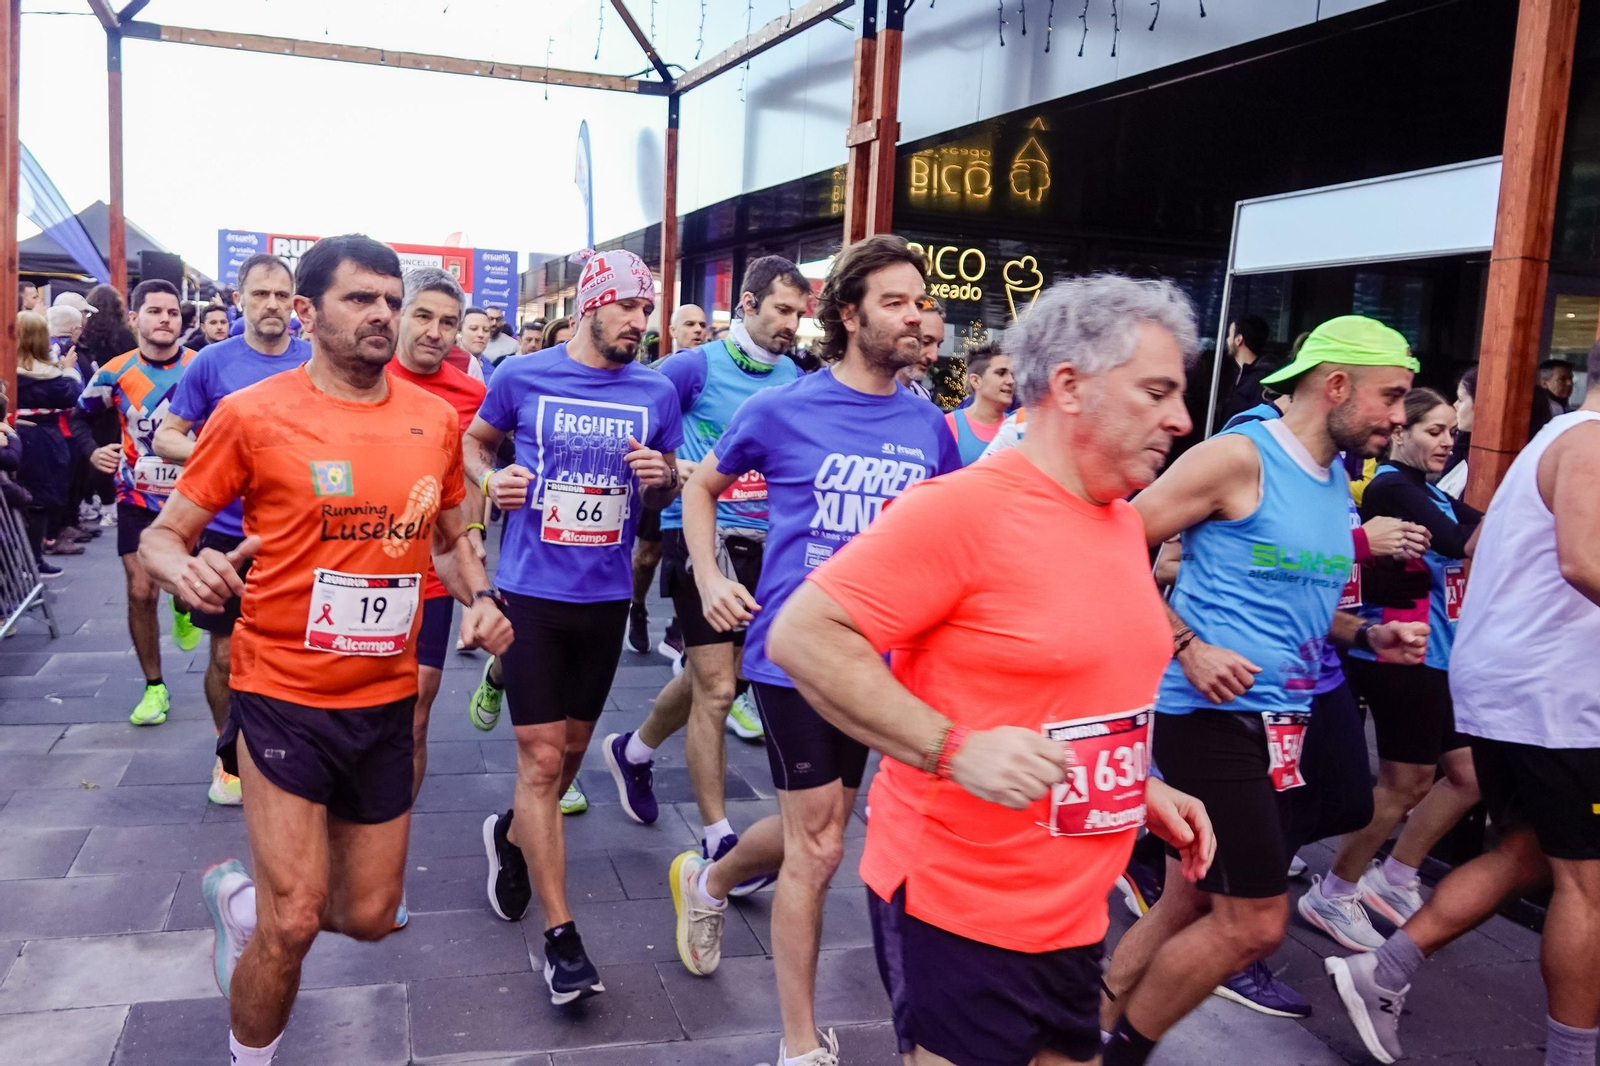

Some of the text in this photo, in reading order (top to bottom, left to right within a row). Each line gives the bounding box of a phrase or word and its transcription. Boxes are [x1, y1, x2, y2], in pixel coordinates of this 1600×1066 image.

[400, 258, 439, 268] ONCELLO
[582, 257, 611, 288] 21
[929, 282, 982, 301] xeado
[554, 408, 635, 438] ÉRGUETE
[321, 501, 388, 519] Running
[576, 500, 603, 522] 66
[809, 490, 893, 533] XUNT
[559, 529, 608, 543] Alcampo
[360, 597, 387, 624] 19
[332, 635, 396, 653] Alcampo
